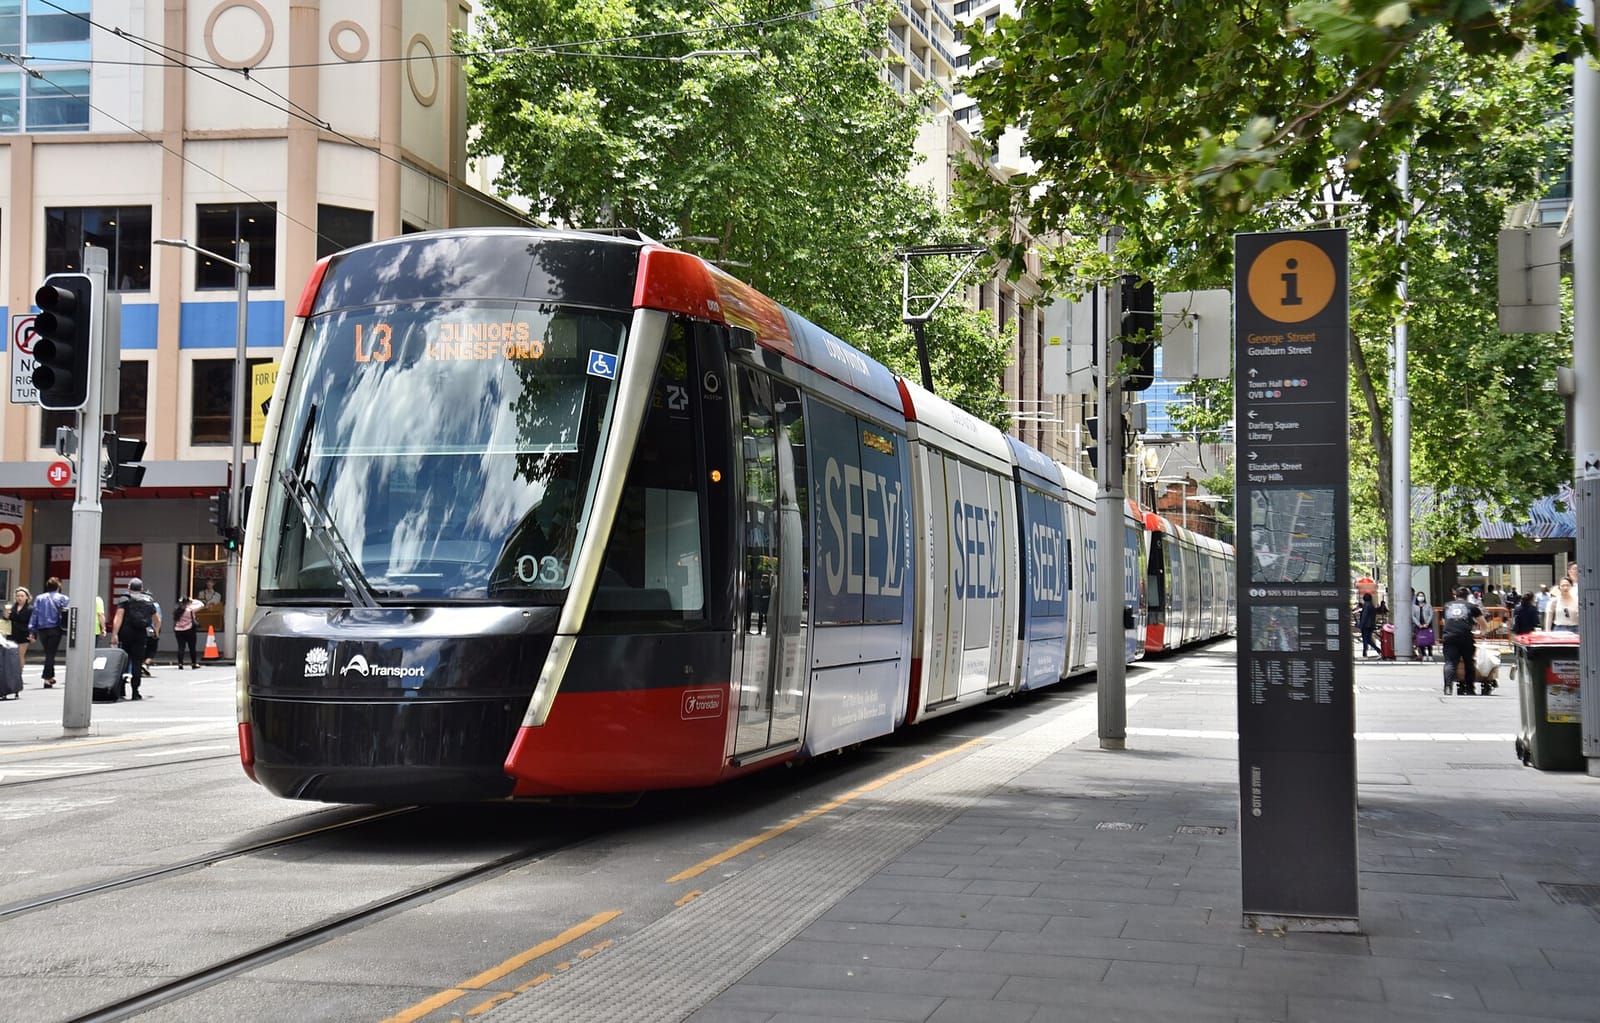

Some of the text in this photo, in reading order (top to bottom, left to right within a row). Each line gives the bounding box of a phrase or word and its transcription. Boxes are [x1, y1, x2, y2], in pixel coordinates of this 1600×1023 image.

[440, 322, 530, 340] JUNIORS
[355, 323, 392, 361] L3
[1247, 332, 1316, 345] George Street
[426, 340, 545, 360] KINGSFORD
[1247, 345, 1313, 356] Goulburn Street
[255, 373, 270, 386] FOR
[1248, 379, 1283, 389] Town Hall
[17, 389, 37, 398] TUR
[1248, 391, 1264, 400] QVB
[1248, 421, 1300, 431] Darling Square
[1248, 431, 1272, 441] Library
[1248, 462, 1303, 471] Elizabeth Street
[1248, 472, 1284, 482] Surry Hills
[517, 555, 560, 583] 03
[304, 663, 327, 674] NSW
[370, 664, 425, 678] Transport
[1251, 766, 1262, 787] SYDNEY
[1252, 795, 1262, 808] CITY
